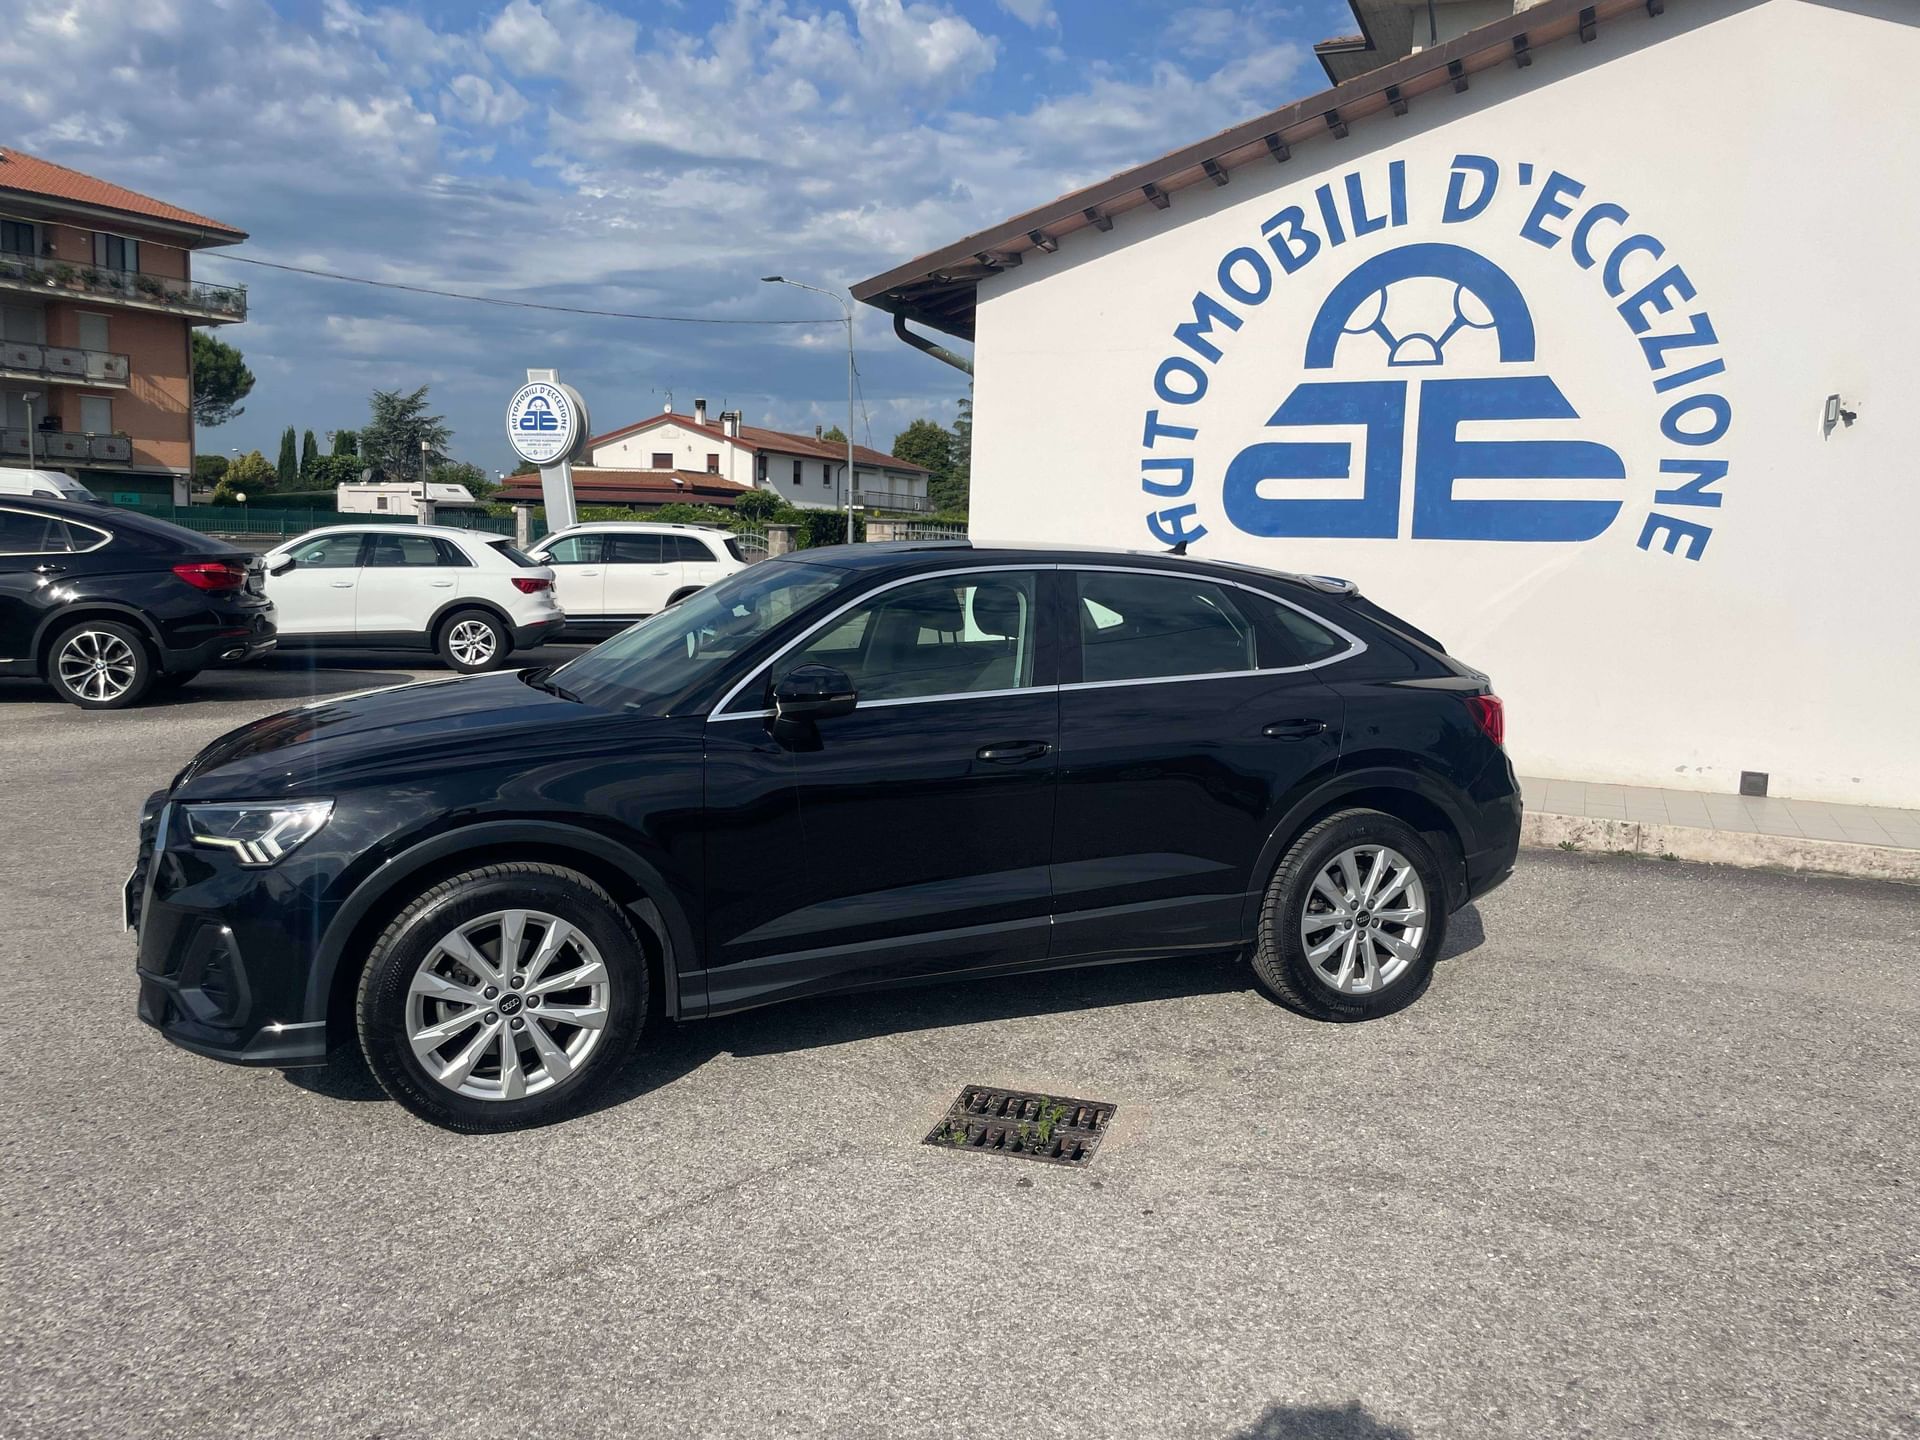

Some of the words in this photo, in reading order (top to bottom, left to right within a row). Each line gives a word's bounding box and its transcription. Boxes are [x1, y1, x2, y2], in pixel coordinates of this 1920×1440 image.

[512, 387, 538, 430] AUTOMOBILI
[540, 387, 567, 430] D'ECCEZIONE
[1142, 159, 1408, 546] AUTOMOBILI
[1442, 155, 1732, 562] D'ECCEZIONE
